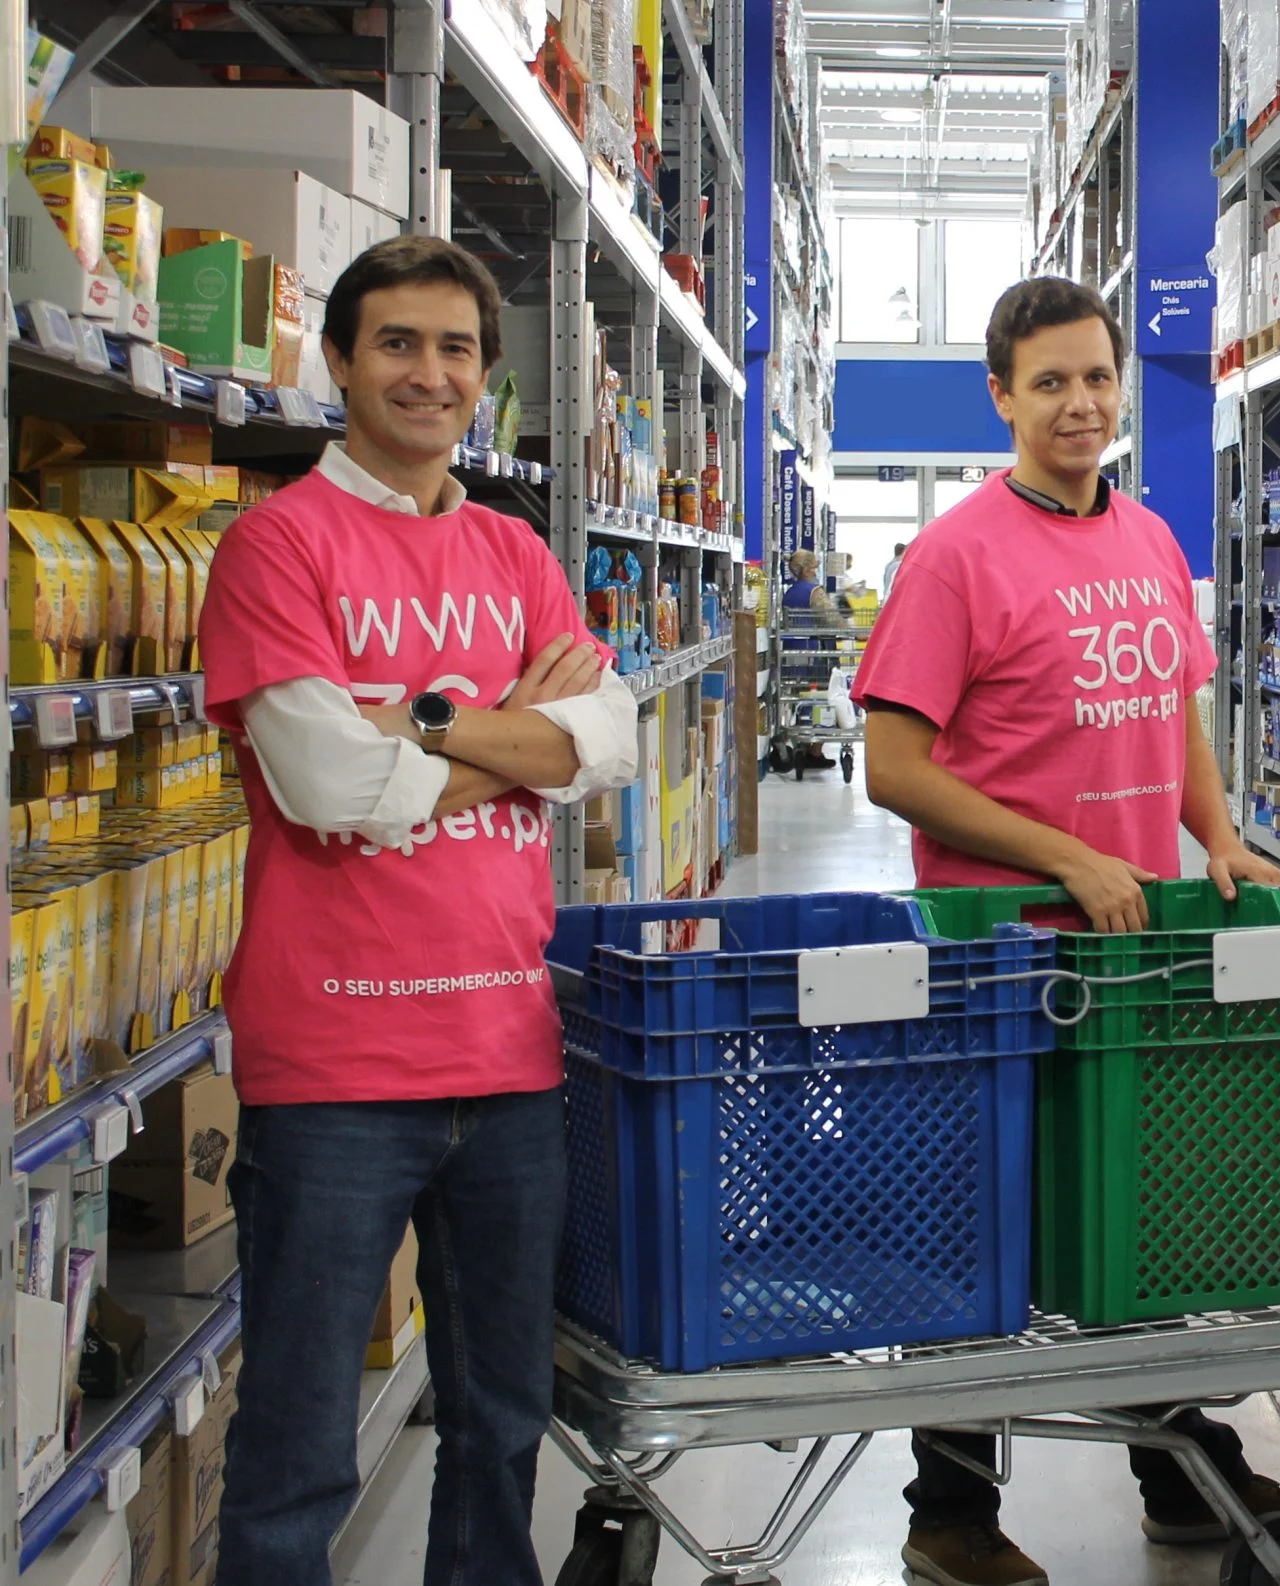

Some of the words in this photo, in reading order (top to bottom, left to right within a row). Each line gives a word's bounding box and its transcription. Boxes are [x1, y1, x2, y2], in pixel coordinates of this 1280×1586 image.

[1150, 276, 1209, 292] Mercearia
[784, 467, 793, 490] Café
[881, 467, 901, 480] 19
[962, 467, 985, 481] 20
[784, 493, 793, 524] Doses
[804, 518, 812, 537] Café
[1069, 617, 1179, 690] 360
[1075, 688, 1178, 729] hyper.pt
[1082, 792, 1099, 801] SEU
[324, 978, 340, 994] O
[345, 980, 384, 996] SEU
[389, 969, 524, 997] SUPERMERCADO
